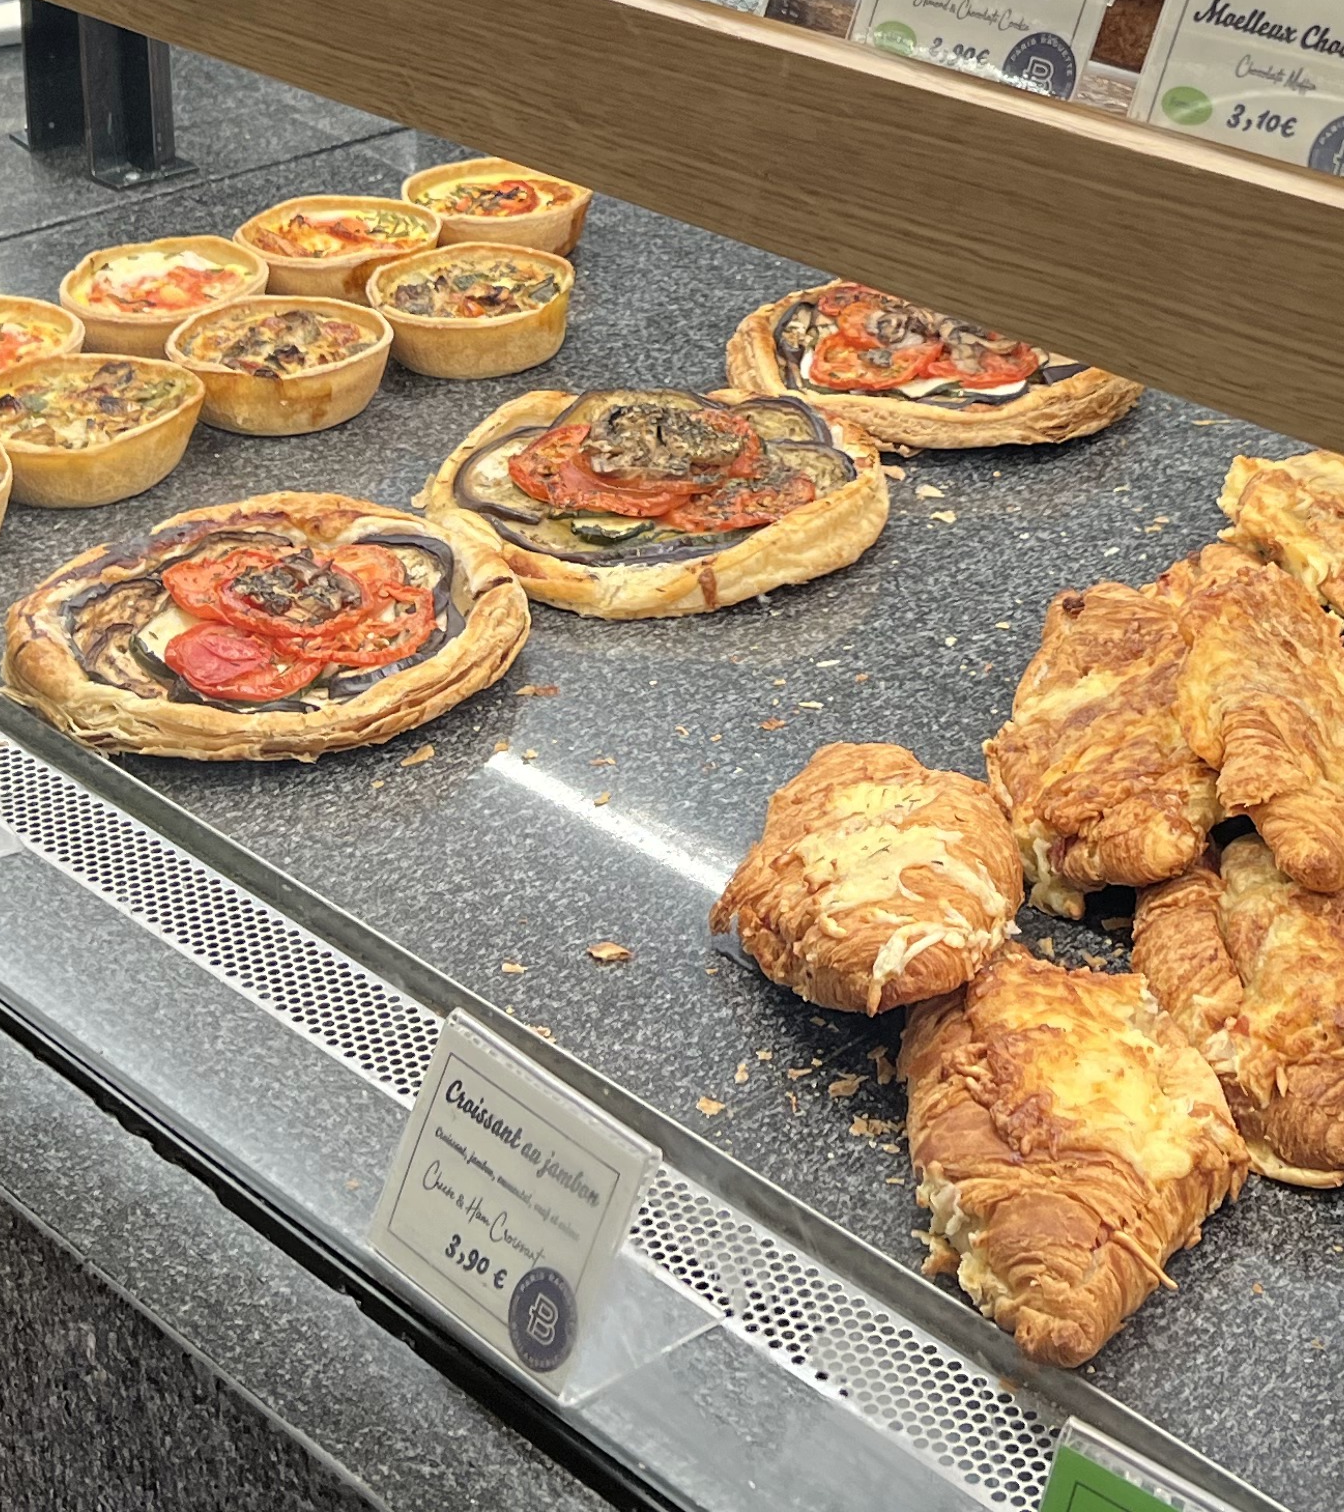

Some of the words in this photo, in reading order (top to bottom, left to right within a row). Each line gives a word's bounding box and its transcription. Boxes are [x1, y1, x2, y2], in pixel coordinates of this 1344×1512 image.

[1226, 103, 1298, 139] 3,10€
[445, 1079, 524, 1150] Croissant
[520, 1142, 542, 1165] au
[535, 1150, 601, 1208] jambon
[464, 1196, 491, 1227] Ham
[445, 1233, 490, 1276] 3,90
[493, 1268, 509, 1290] €
